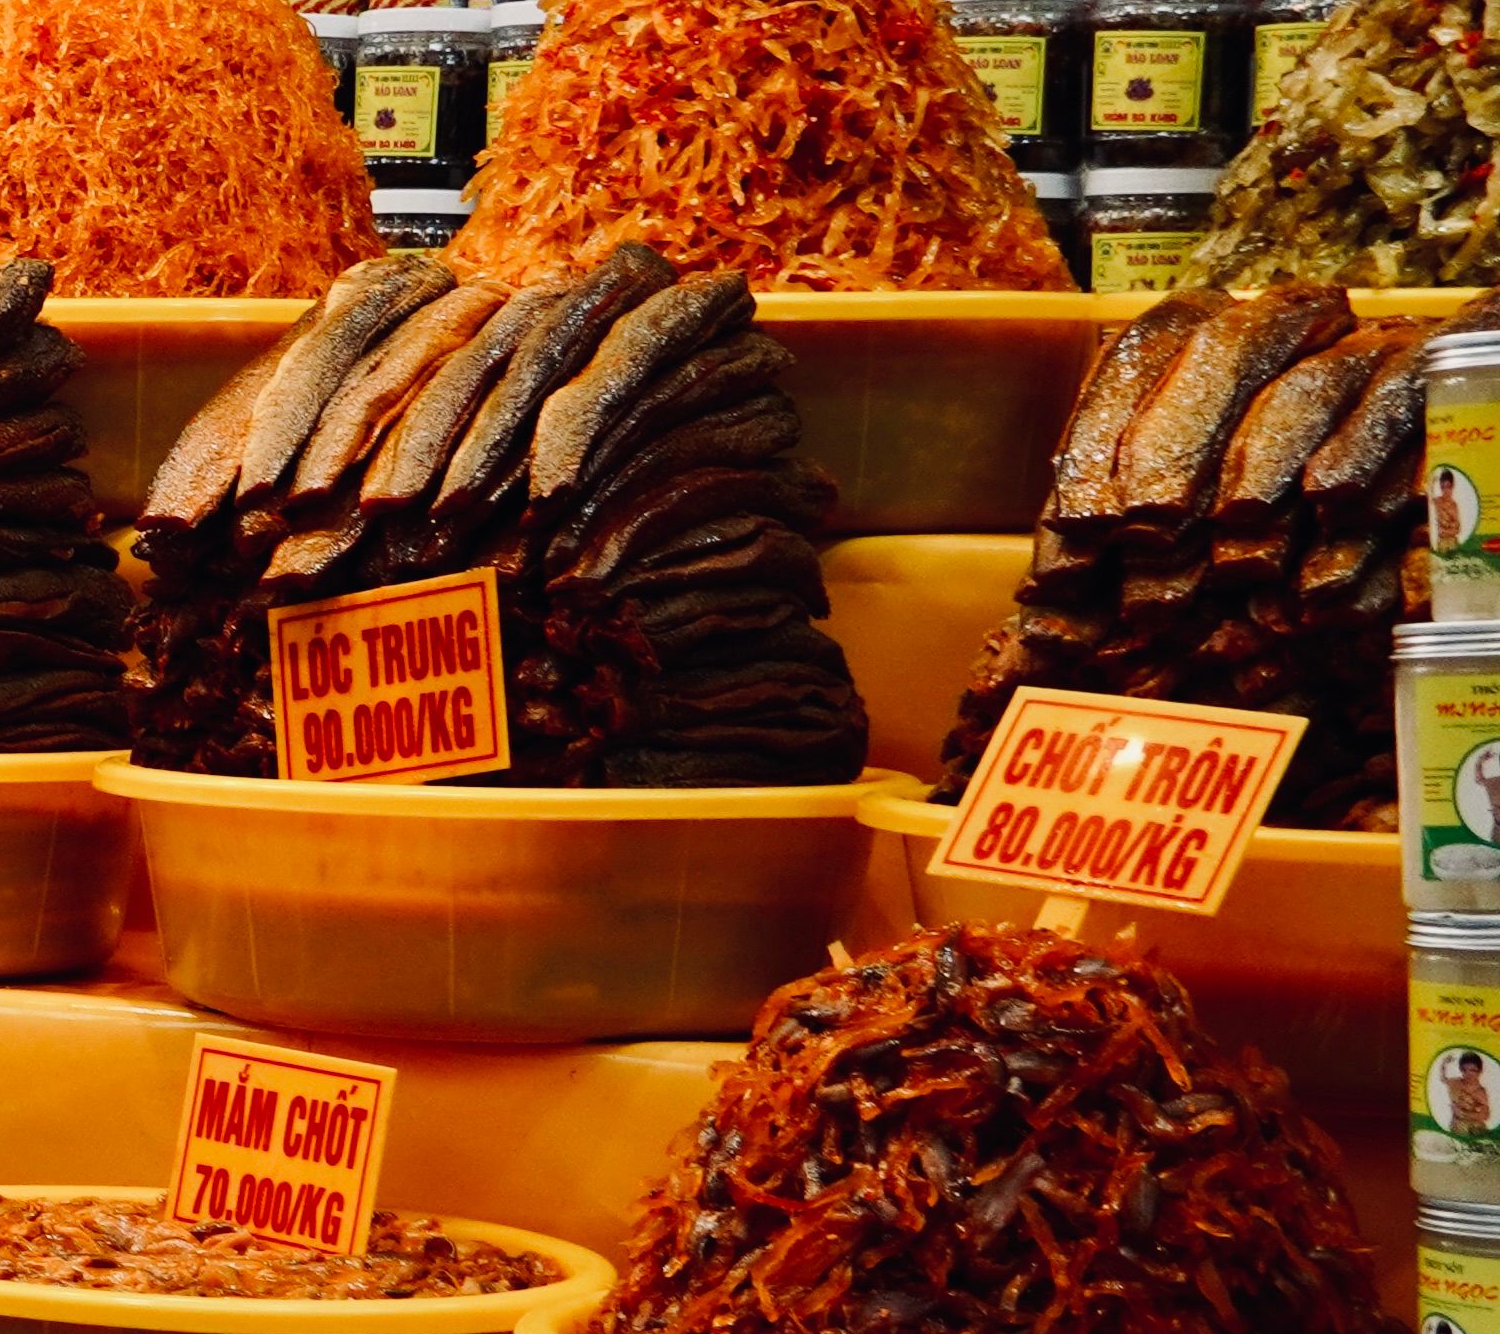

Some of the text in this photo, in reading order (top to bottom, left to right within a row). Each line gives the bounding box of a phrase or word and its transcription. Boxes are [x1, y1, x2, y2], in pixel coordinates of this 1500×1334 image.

[288, 608, 483, 703] LÓC TRUNG
[304, 683, 476, 775] 90.000/KG
[1002, 717, 1120, 803] CHỐT
[972, 800, 1209, 891] 80.000/KG
[196, 1062, 370, 1171] MẮM CHỐT
[191, 1162, 344, 1247] 70.000/KG
